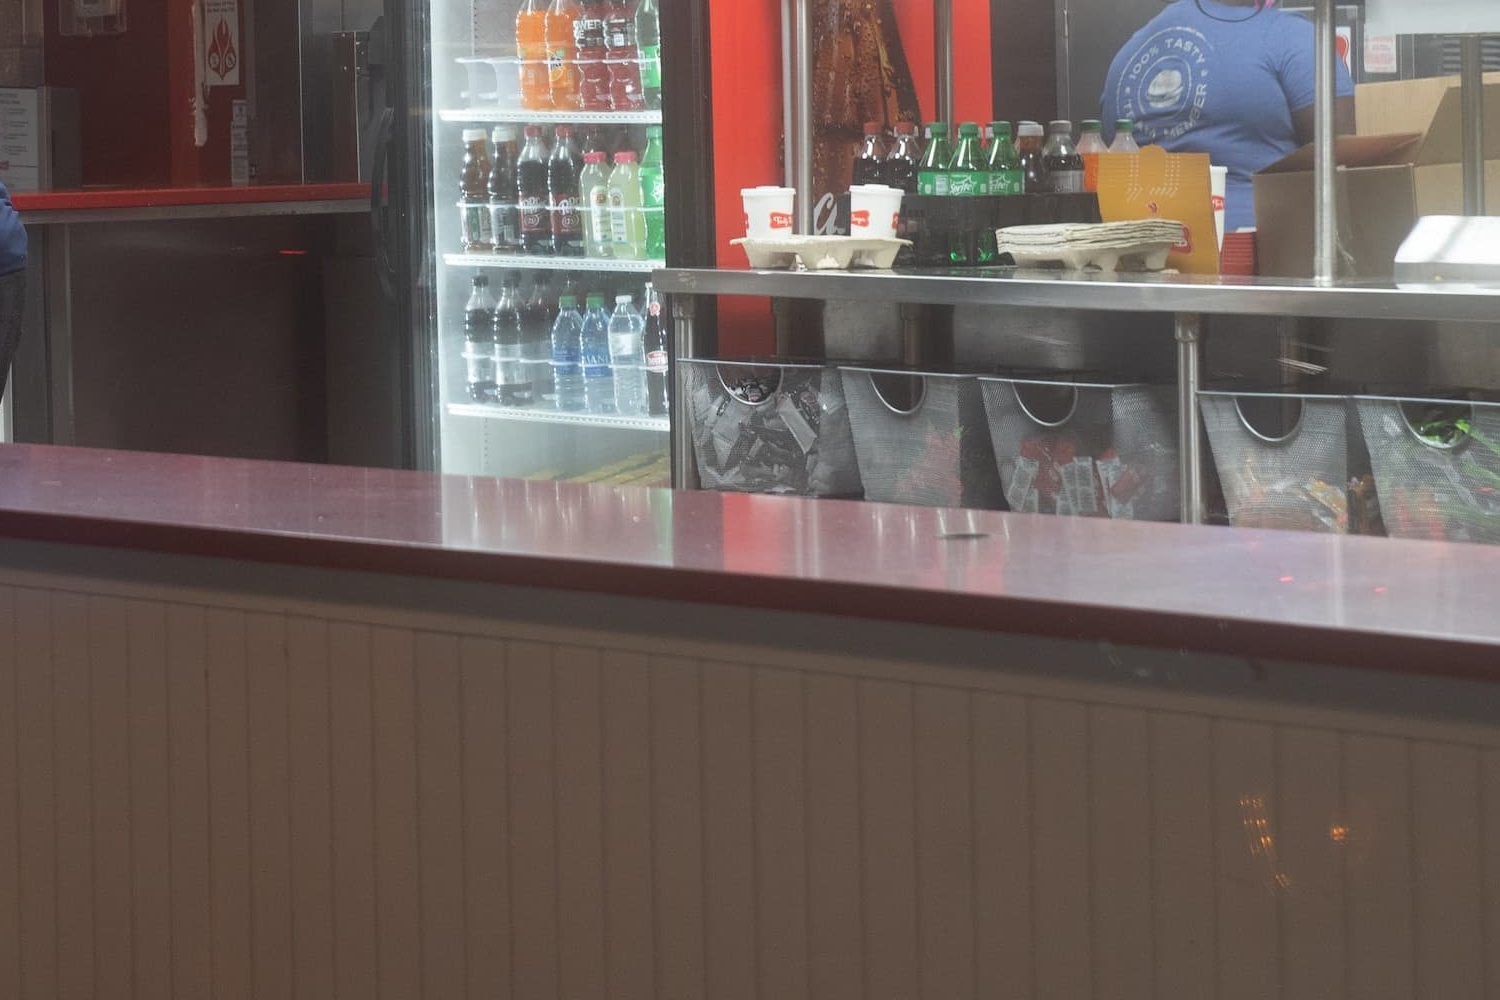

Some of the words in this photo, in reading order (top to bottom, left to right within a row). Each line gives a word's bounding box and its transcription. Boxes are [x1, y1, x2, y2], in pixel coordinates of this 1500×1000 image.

[1129, 45, 1160, 80] 100%
[1165, 37, 1206, 65] TASTY
[949, 182, 973, 194] Sprite
